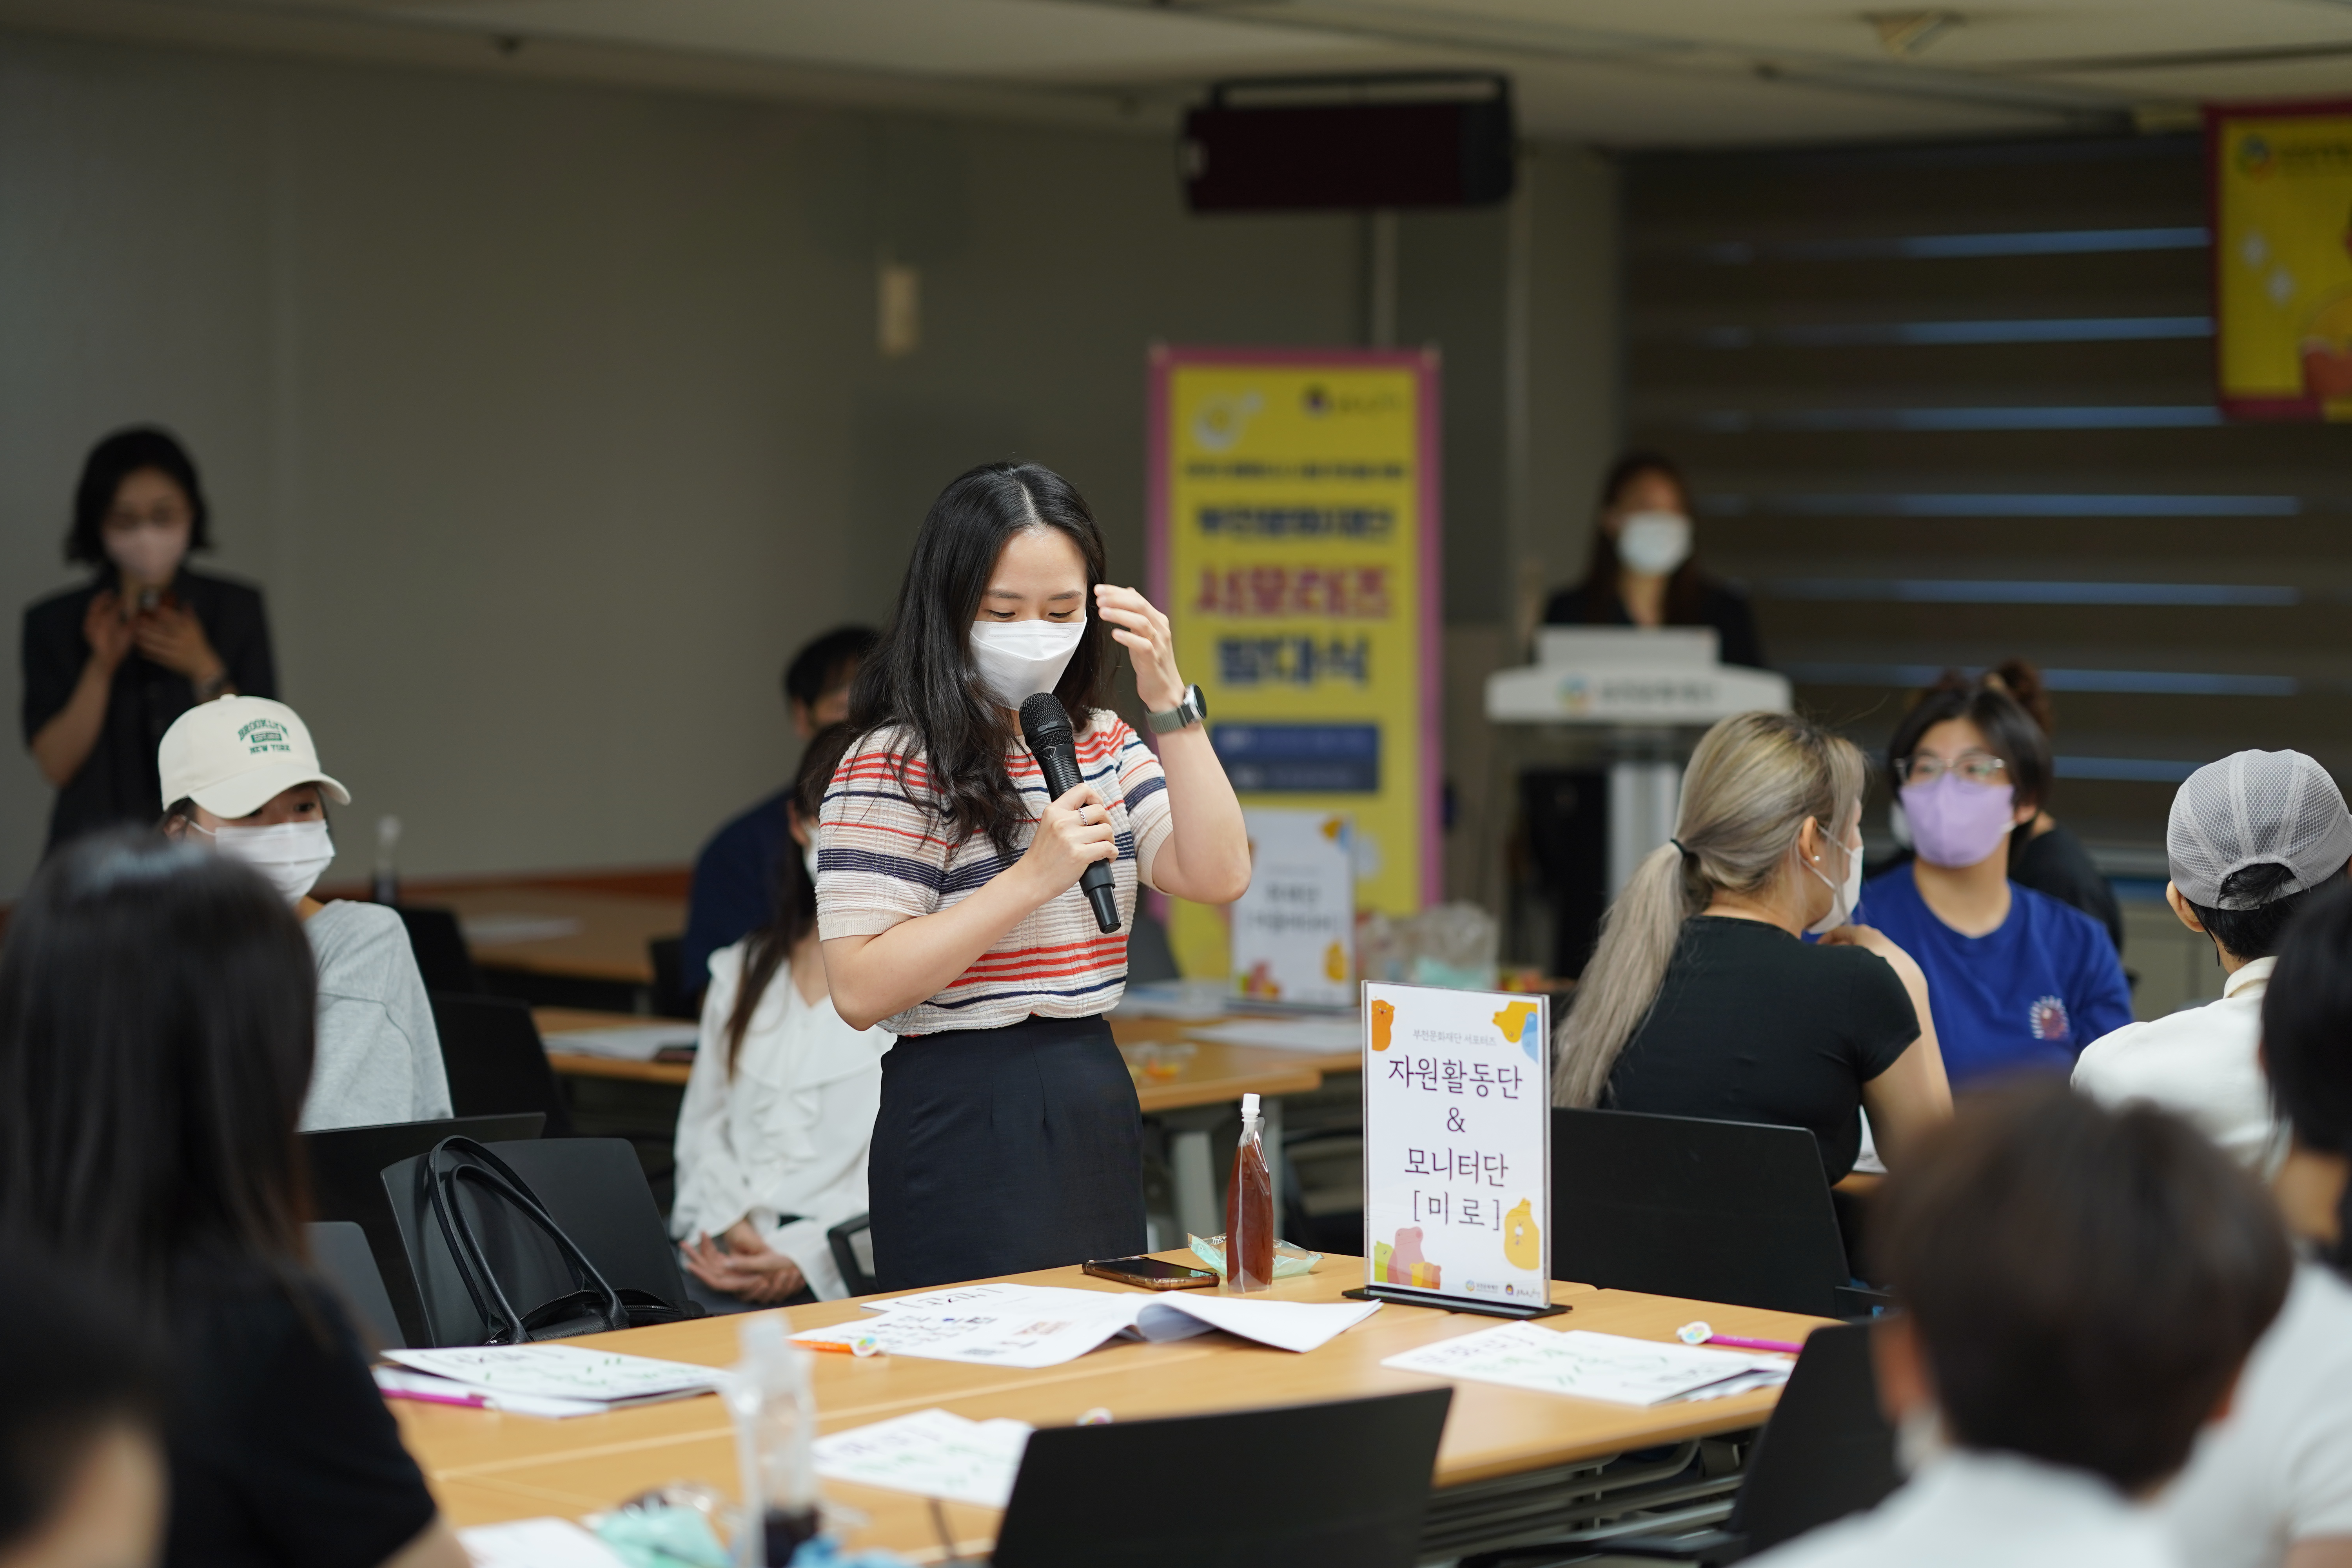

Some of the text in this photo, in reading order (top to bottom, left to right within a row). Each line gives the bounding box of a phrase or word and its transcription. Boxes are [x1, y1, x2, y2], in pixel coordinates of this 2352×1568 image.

[238, 718, 289, 741] BROOKLYN
[249, 743, 291, 755] NEW YORK
[1412, 1029, 1497, 1046] 부천문화재단 서포터즈
[1388, 1054, 1523, 1100] 자원활동단
[1447, 1107, 1466, 1133] &
[1405, 1147, 1509, 1187] 모니터단
